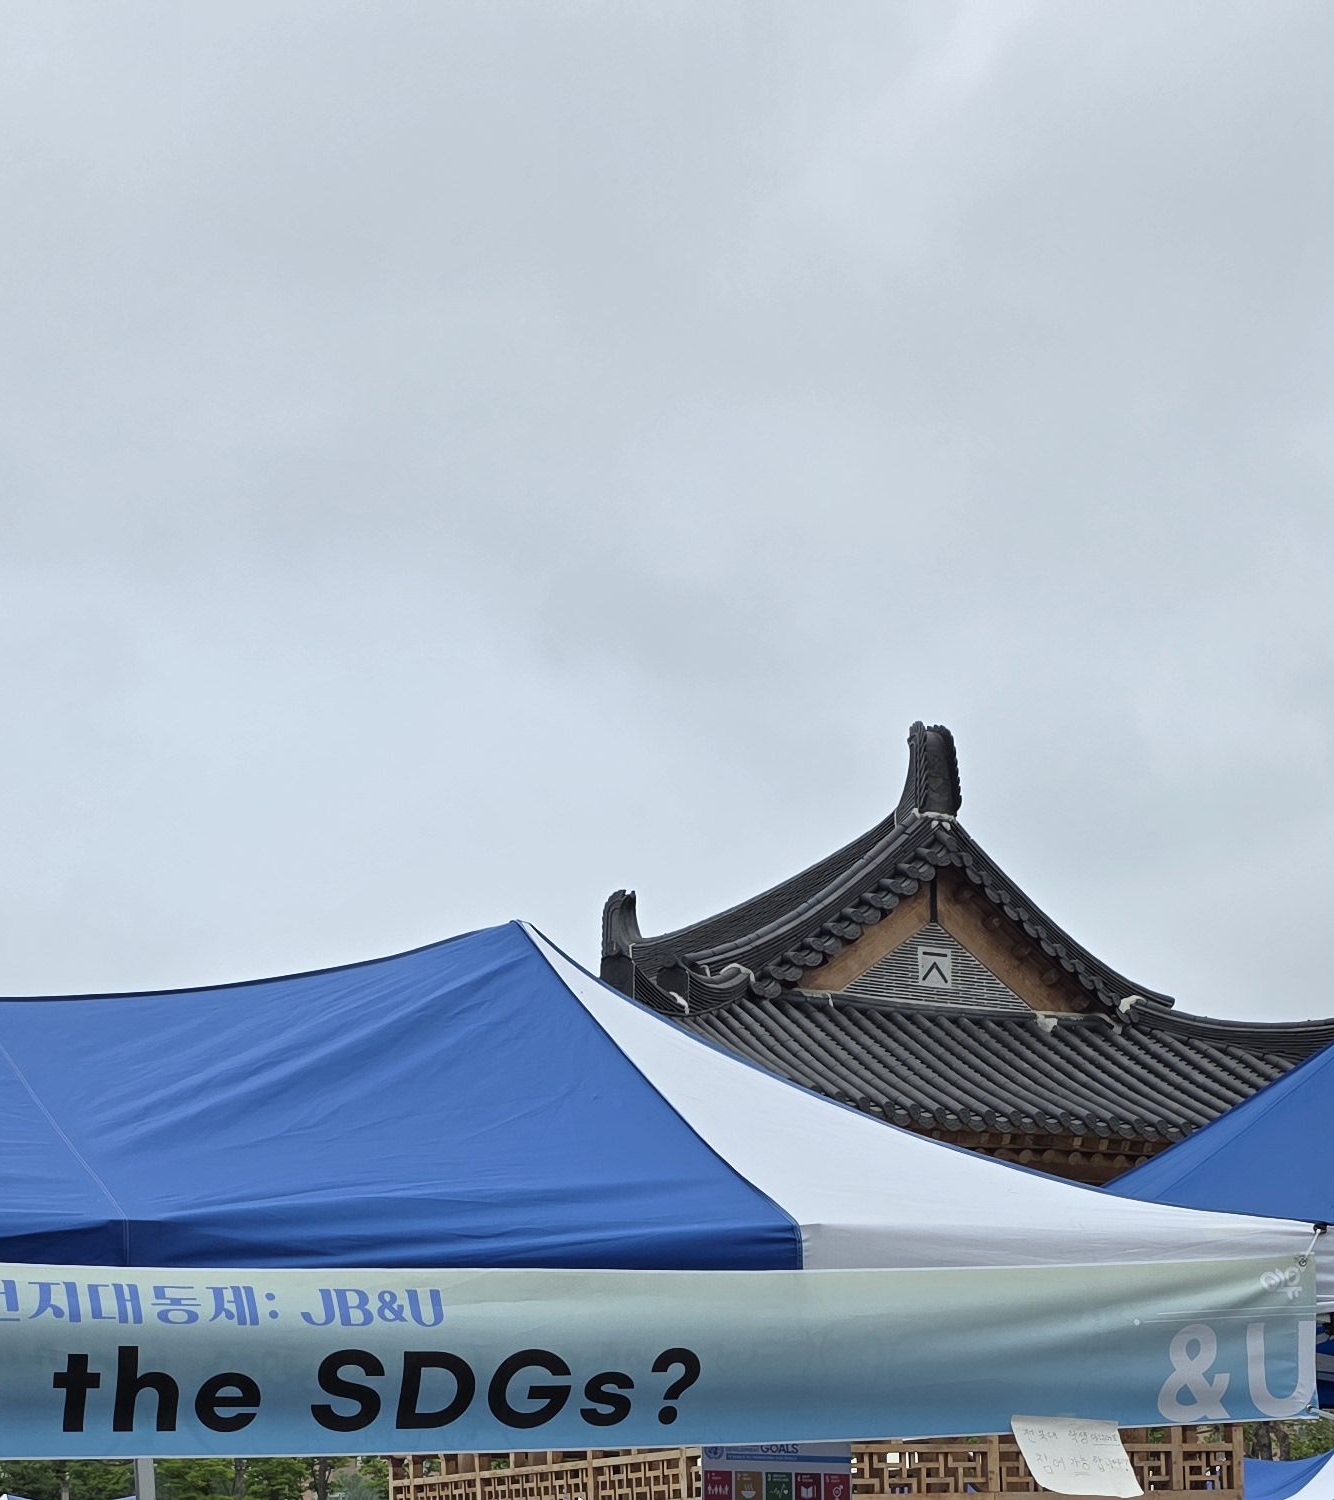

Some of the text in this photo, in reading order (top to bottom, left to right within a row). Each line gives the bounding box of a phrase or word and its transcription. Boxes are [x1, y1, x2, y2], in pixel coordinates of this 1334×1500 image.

[300, 1287, 445, 1328] JB&U
[52, 1345, 262, 1433] the
[310, 1346, 701, 1433] SDGs?
[761, 1443, 799, 1454] GOALS
